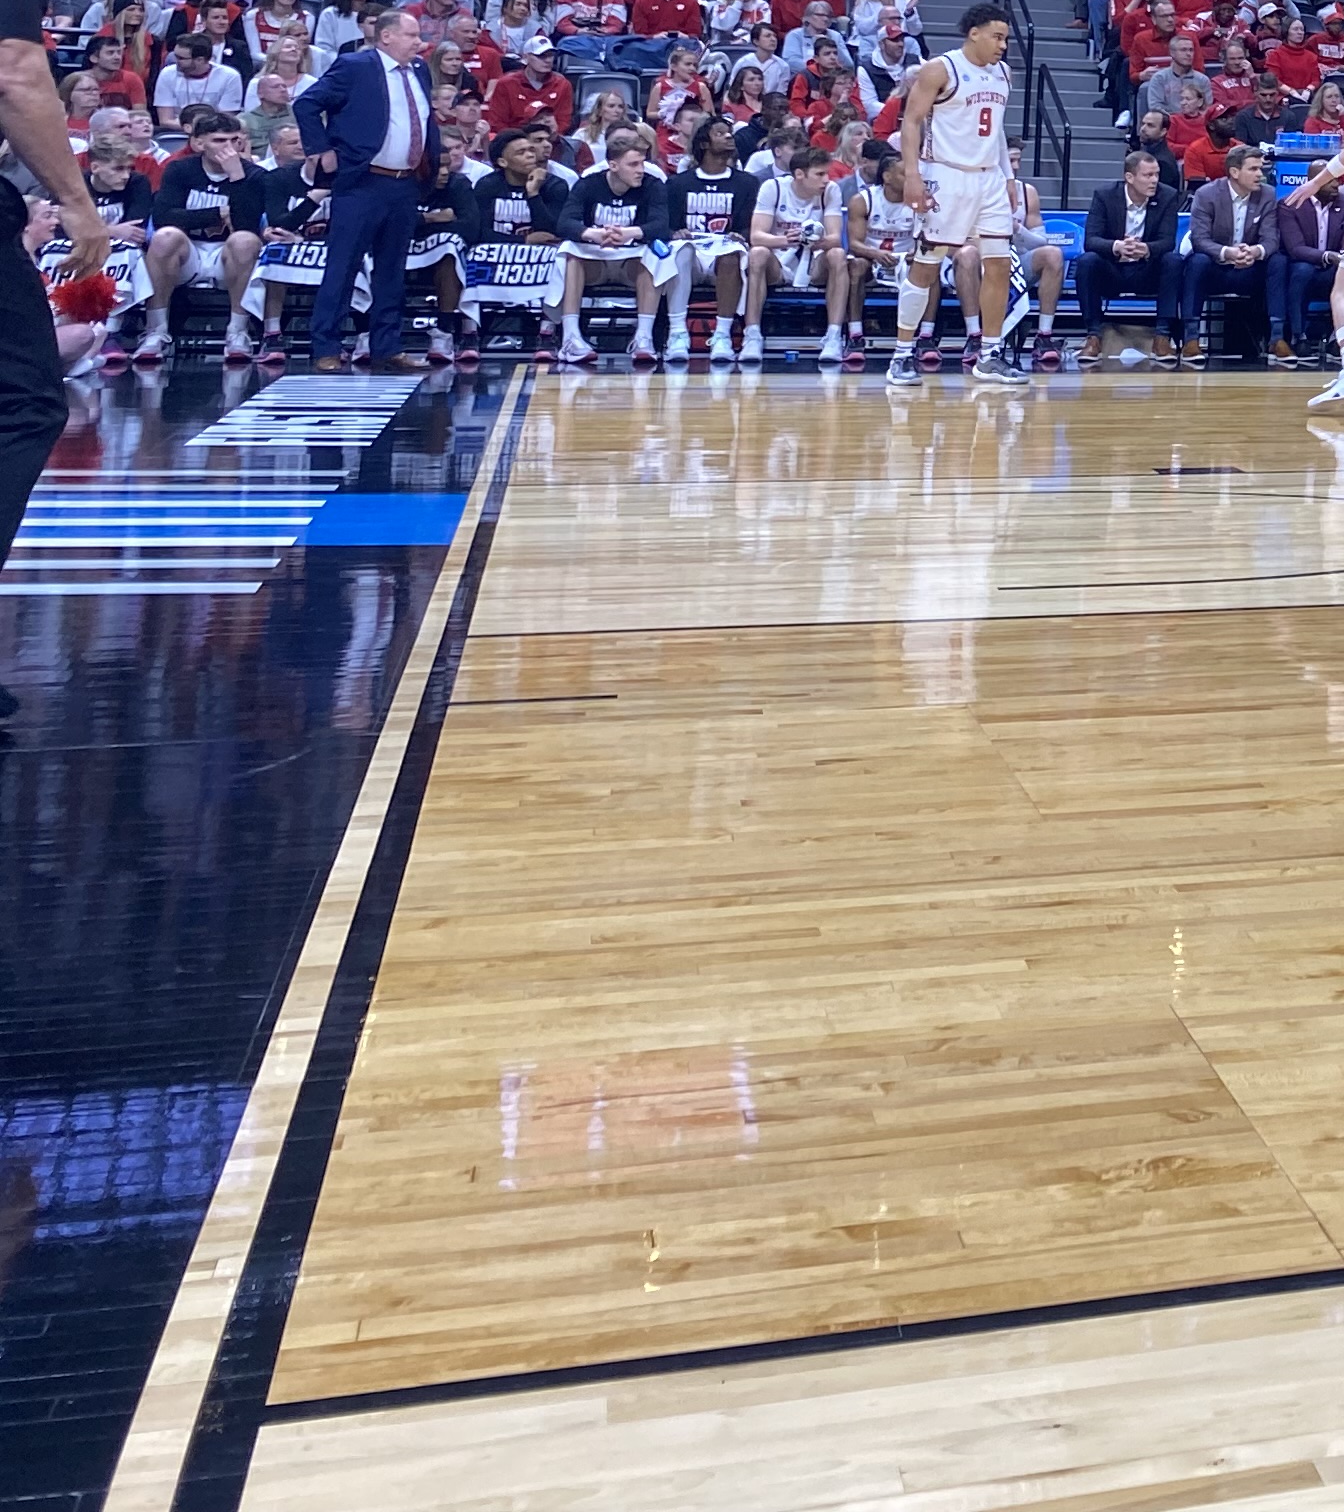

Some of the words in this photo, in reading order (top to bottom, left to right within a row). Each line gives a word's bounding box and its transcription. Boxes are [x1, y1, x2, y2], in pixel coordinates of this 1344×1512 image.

[977, 107, 993, 138] 9
[686, 191, 734, 215] DOUBT
[686, 214, 706, 233] US
